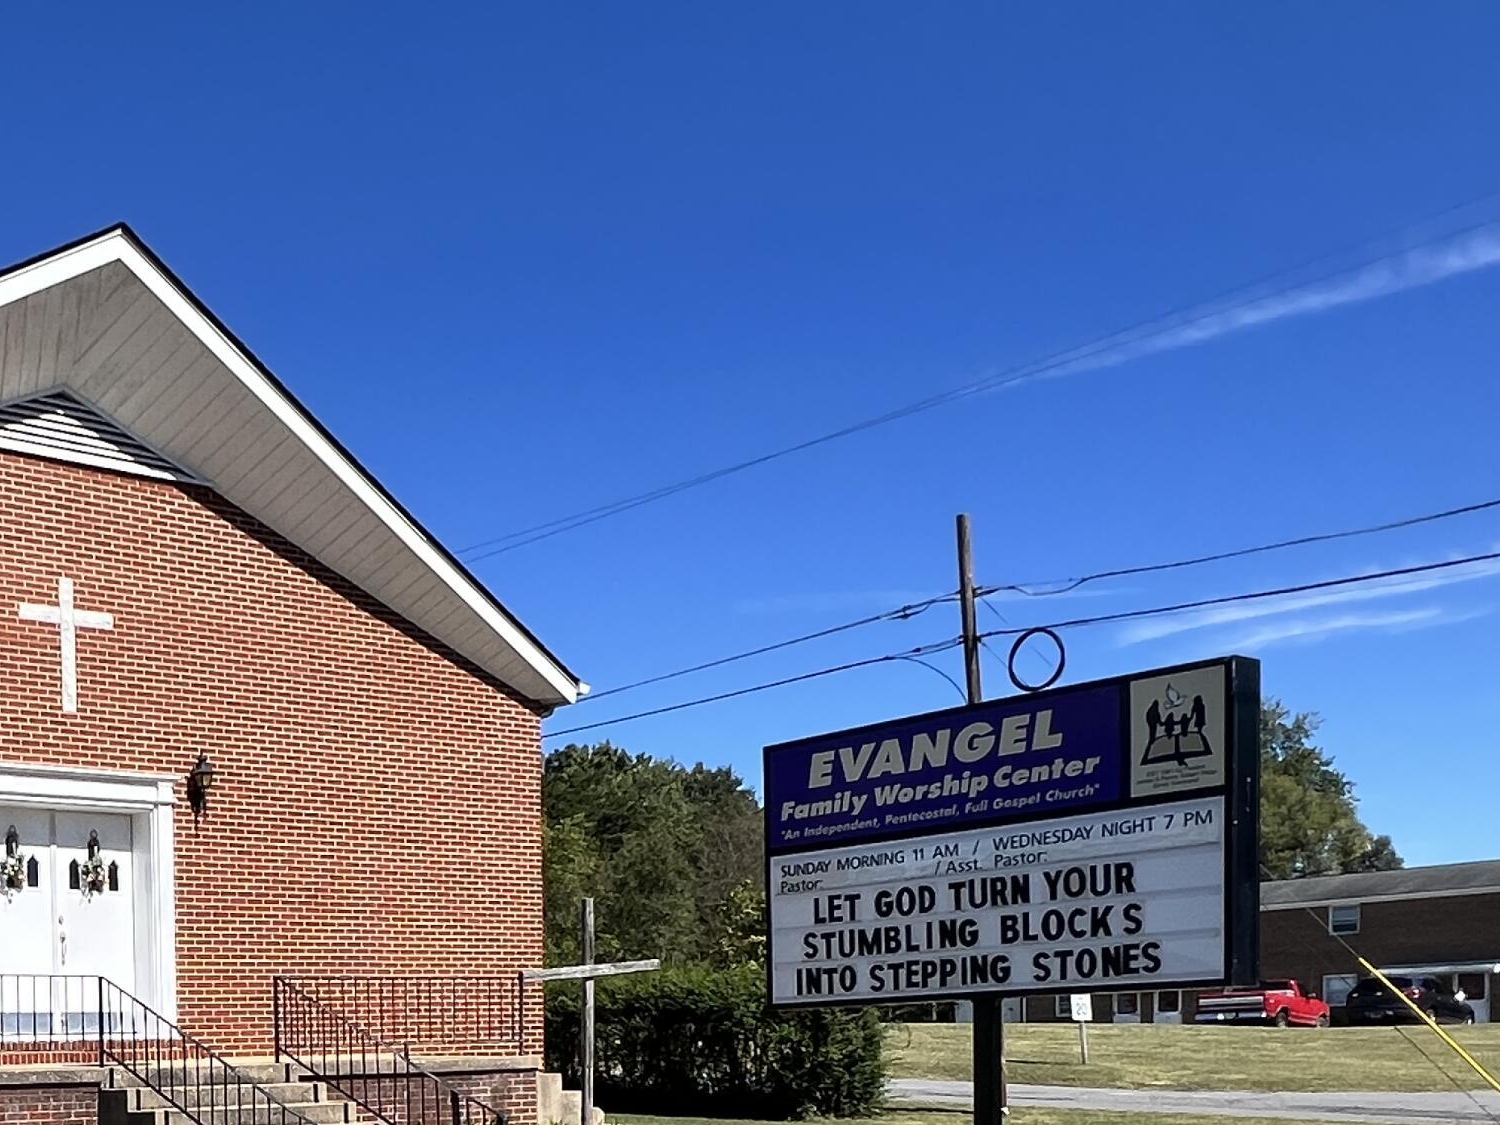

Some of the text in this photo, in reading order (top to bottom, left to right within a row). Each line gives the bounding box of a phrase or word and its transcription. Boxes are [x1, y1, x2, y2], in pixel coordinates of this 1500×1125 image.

[808, 709, 1063, 789] EVANGEL
[780, 790, 868, 821] Family
[874, 771, 989, 807] Worship
[993, 756, 1100, 788] Center
[804, 817, 881, 837] Independent,
[885, 804, 960, 826] Pentecostal,
[964, 800, 988, 814] Full
[993, 792, 1041, 809] Gospel
[781, 809, 1213, 878] SUNDAY MORNING 11 AM / WEDNESDAY NIGHT 7 PM
[934, 860, 942, 876] /
[945, 858, 983, 875] Asst.
[813, 861, 1136, 925] LET GOD TURN YOUR
[803, 903, 1143, 959] STUMBLING BLOCKS
[796, 941, 1162, 996] INTO STEPPING STONES
